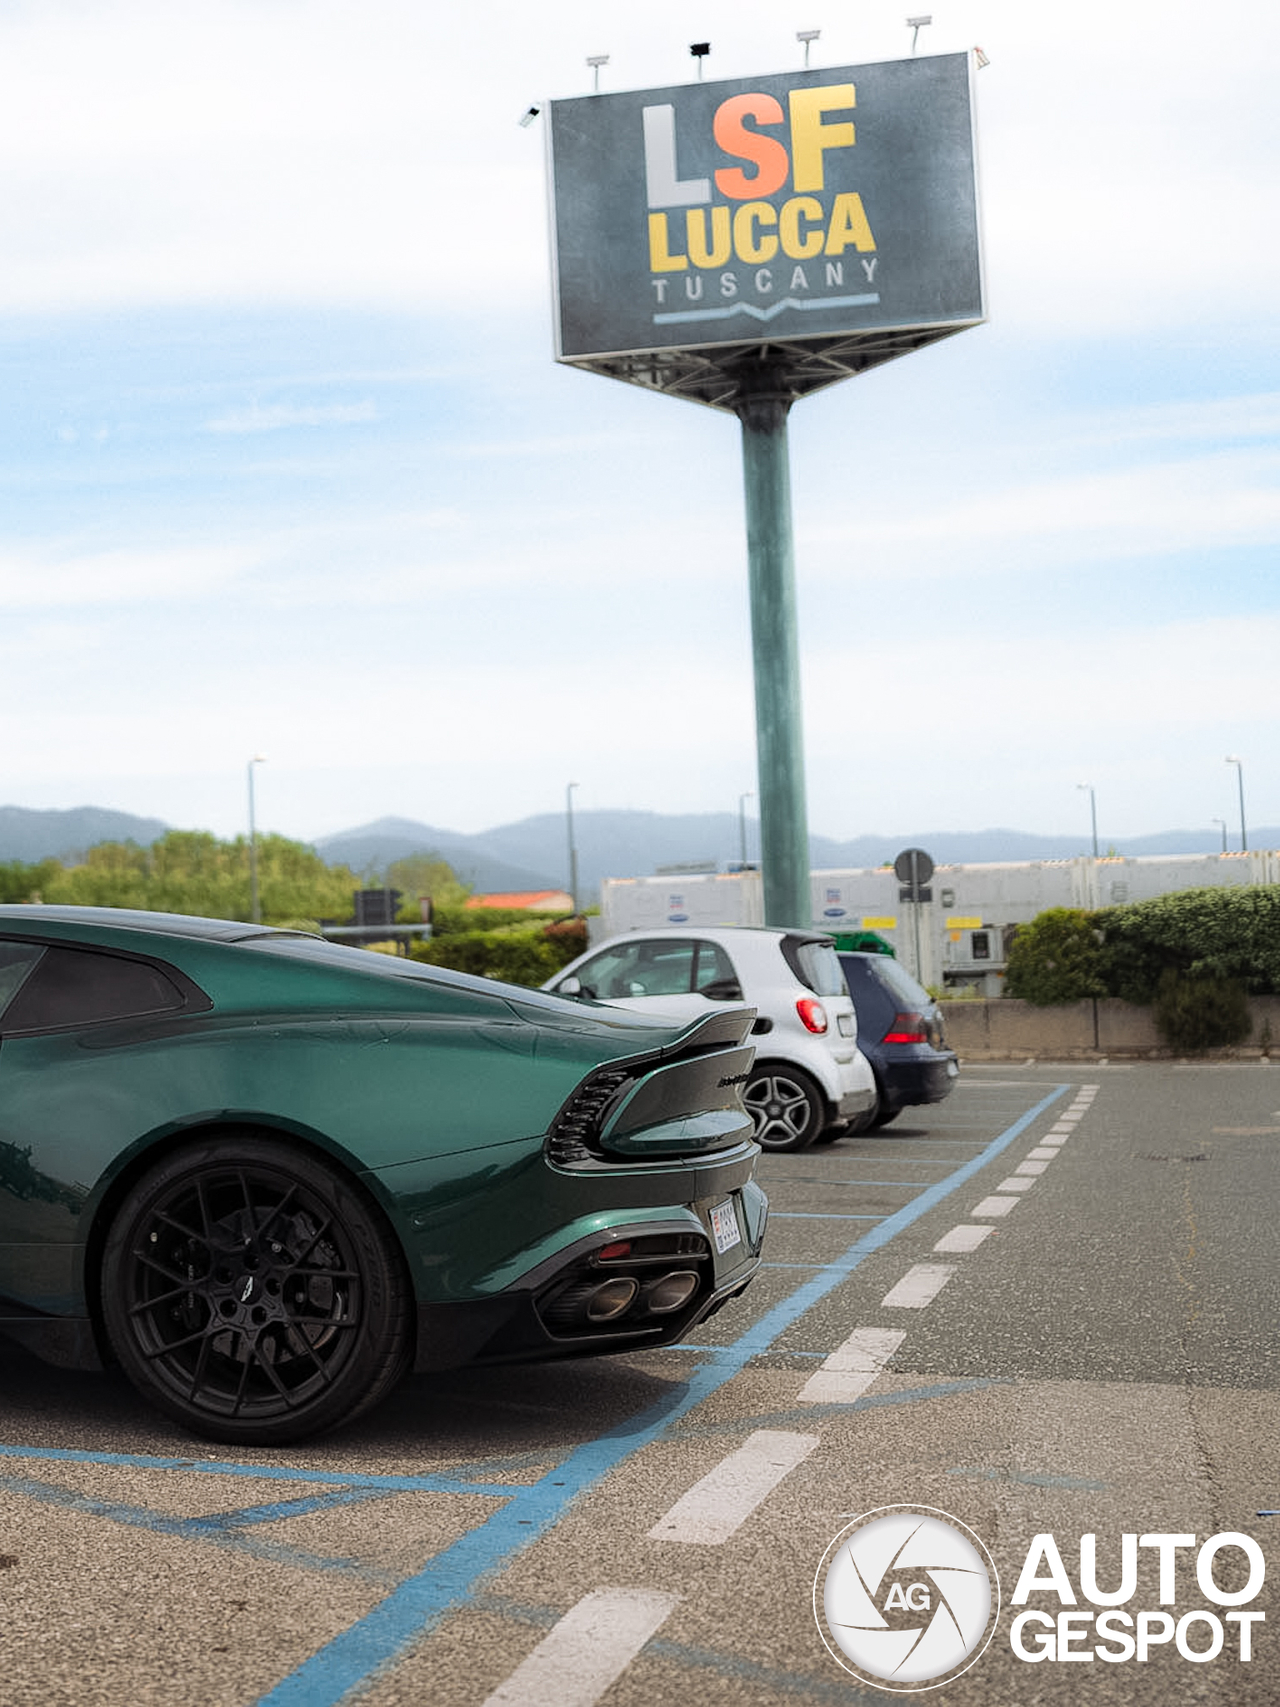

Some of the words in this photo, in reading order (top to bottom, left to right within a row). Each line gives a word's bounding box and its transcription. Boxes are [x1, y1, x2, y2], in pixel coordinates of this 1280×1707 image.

[642, 83, 856, 208] LSF
[648, 192, 877, 273] LUCCA
[652, 258, 878, 303] TUSCANY
